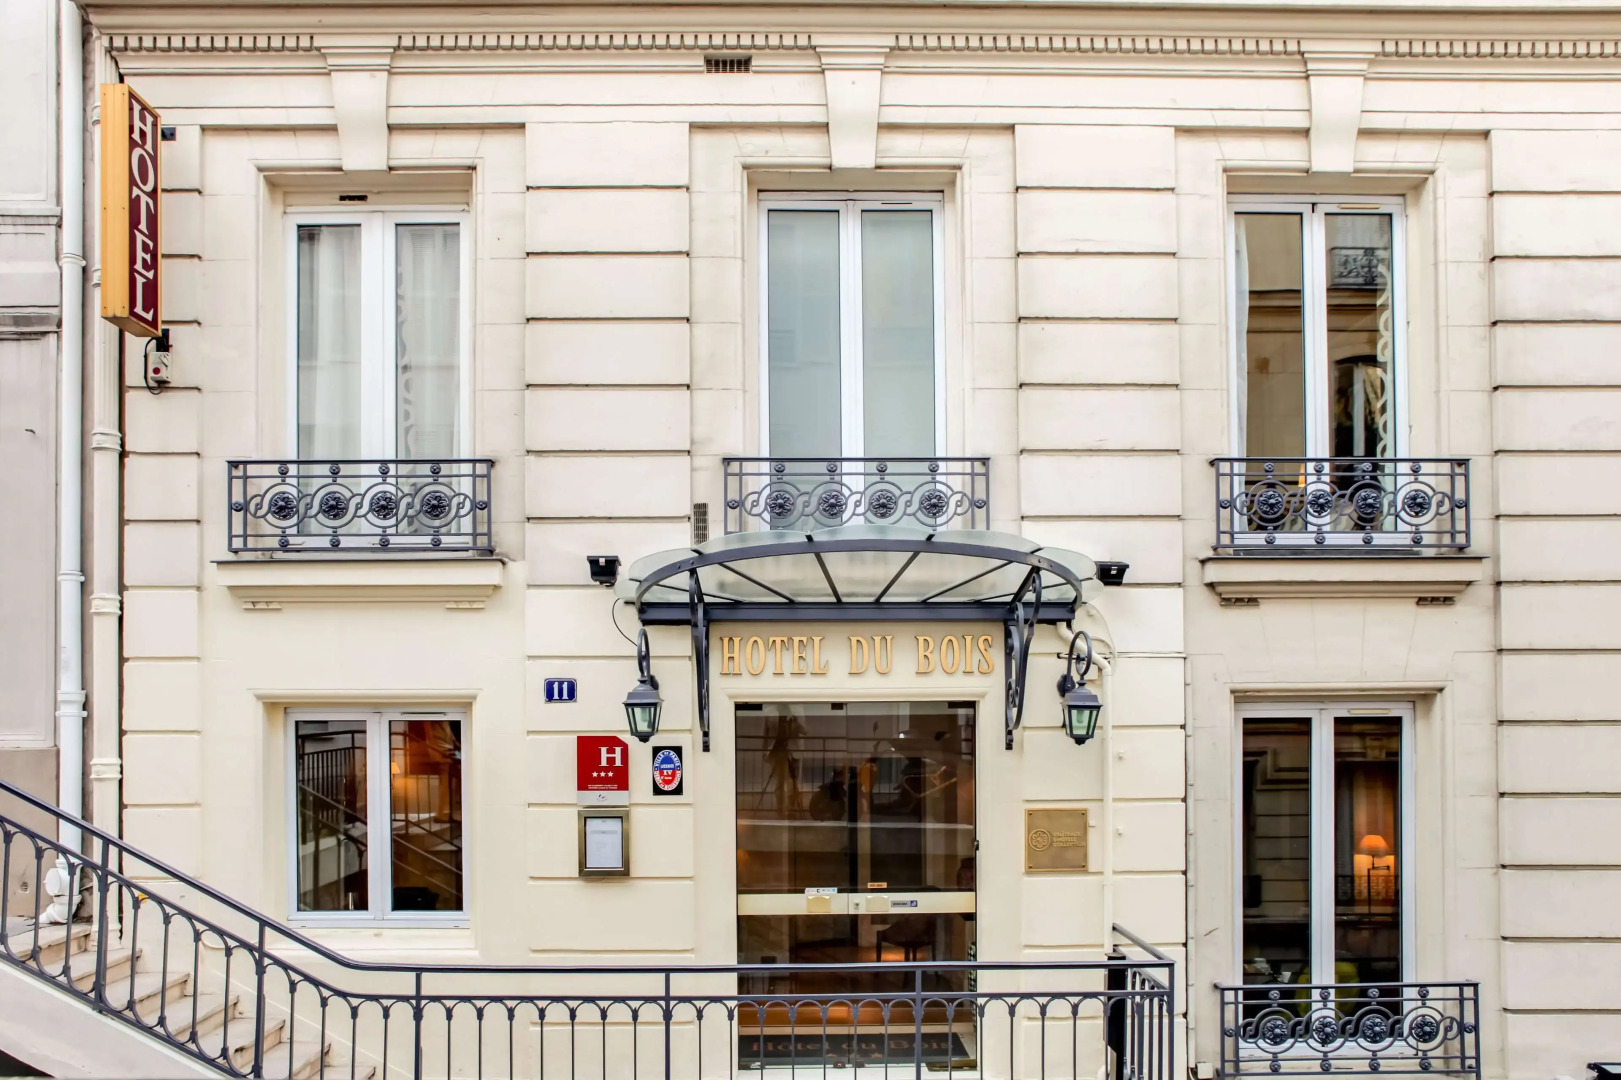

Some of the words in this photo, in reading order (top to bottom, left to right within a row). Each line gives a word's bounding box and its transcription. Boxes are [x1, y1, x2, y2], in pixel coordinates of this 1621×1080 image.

[131, 97, 155, 322] HOTEL
[720, 636, 829, 676] HOTEL
[848, 635, 893, 675] DU
[914, 635, 995, 675] BOIS
[552, 681, 569, 700] 11
[598, 746, 624, 767] H
